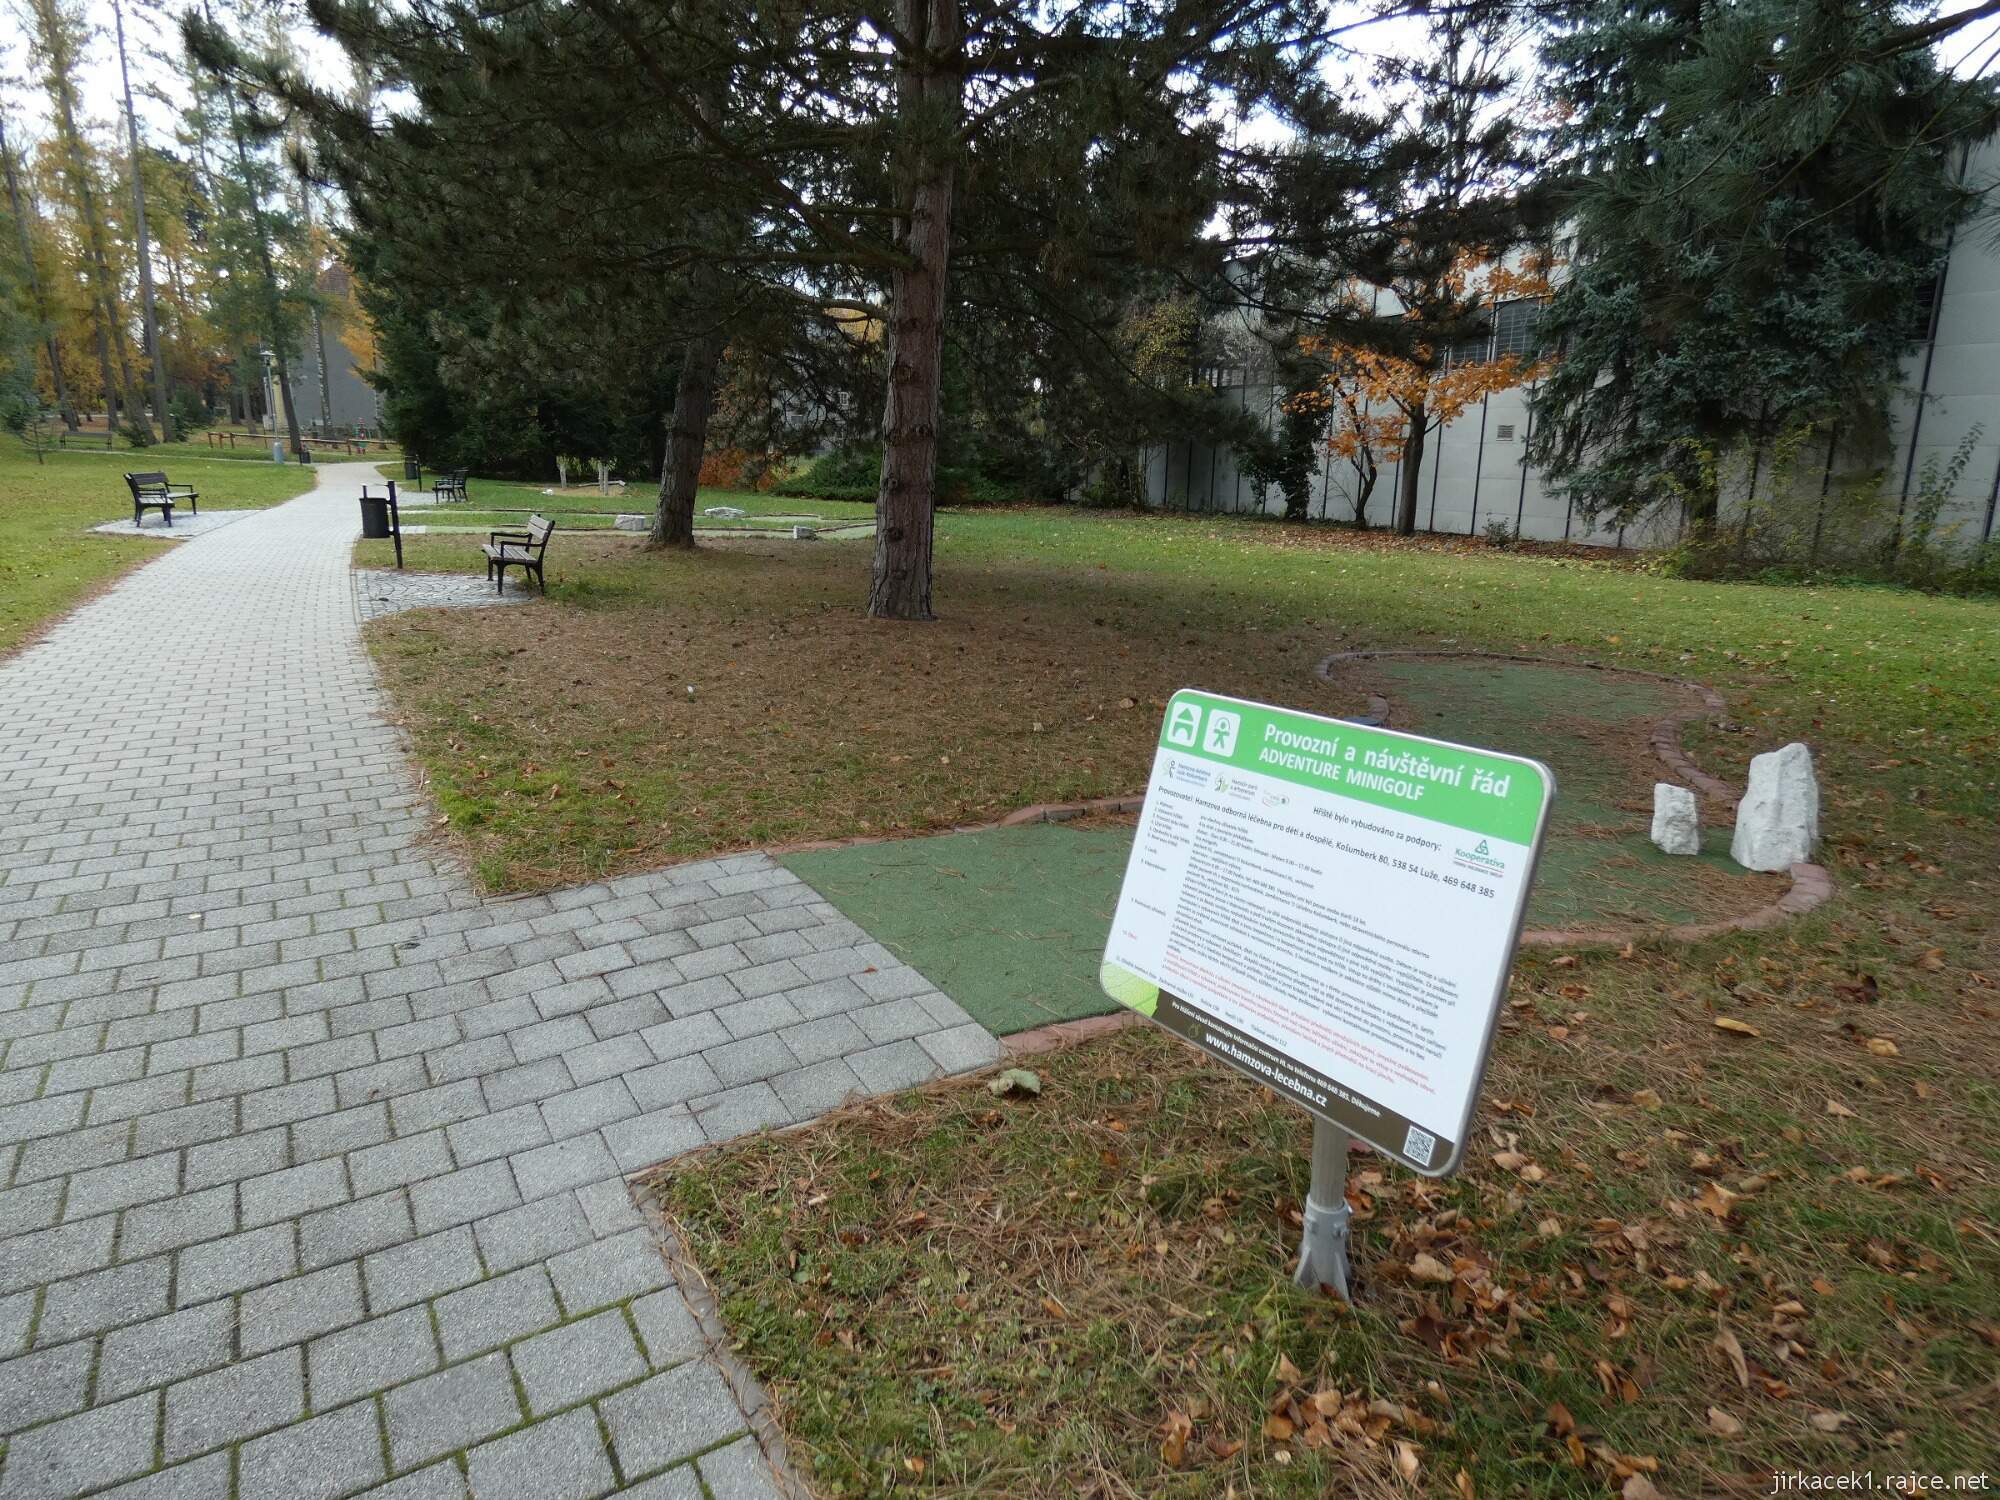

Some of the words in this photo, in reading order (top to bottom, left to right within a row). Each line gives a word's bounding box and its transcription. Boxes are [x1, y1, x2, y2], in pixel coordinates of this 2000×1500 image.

[1258, 747, 1341, 780] ADVENTURE
[1345, 768, 1424, 800] MINIGOLF
[1264, 723, 1339, 756] Provozní
[1344, 745, 1356, 761] a
[1364, 748, 1463, 786] návštěvní
[1470, 767, 1510, 797] řád
[1194, 796, 1220, 811] Hamzova
[1221, 806, 1246, 818] odborná
[1247, 812, 1272, 827] léčebna
[1272, 822, 1284, 831] pro
[1284, 825, 1298, 835] děti
[1335, 841, 1377, 860] Košumberk
[1377, 854, 1389, 865] 80,
[1391, 858, 1407, 870] 538
[1407, 863, 1418, 873] 54
[1419, 867, 1440, 881] Luže,
[1442, 874, 1458, 886] 469
[1459, 880, 1477, 892] 648
[1478, 885, 1494, 898] 385
[1313, 806, 1333, 818] Hřiště
[1333, 812, 1349, 823] bylo
[1350, 819, 1394, 837] vybudováno
[1395, 831, 1404, 840] za
[1404, 834, 1441, 851] podpory:
[1454, 848, 1505, 869] Kooperativa
[1204, 1032, 1328, 1107] www.hamzova-lecebna.cz
